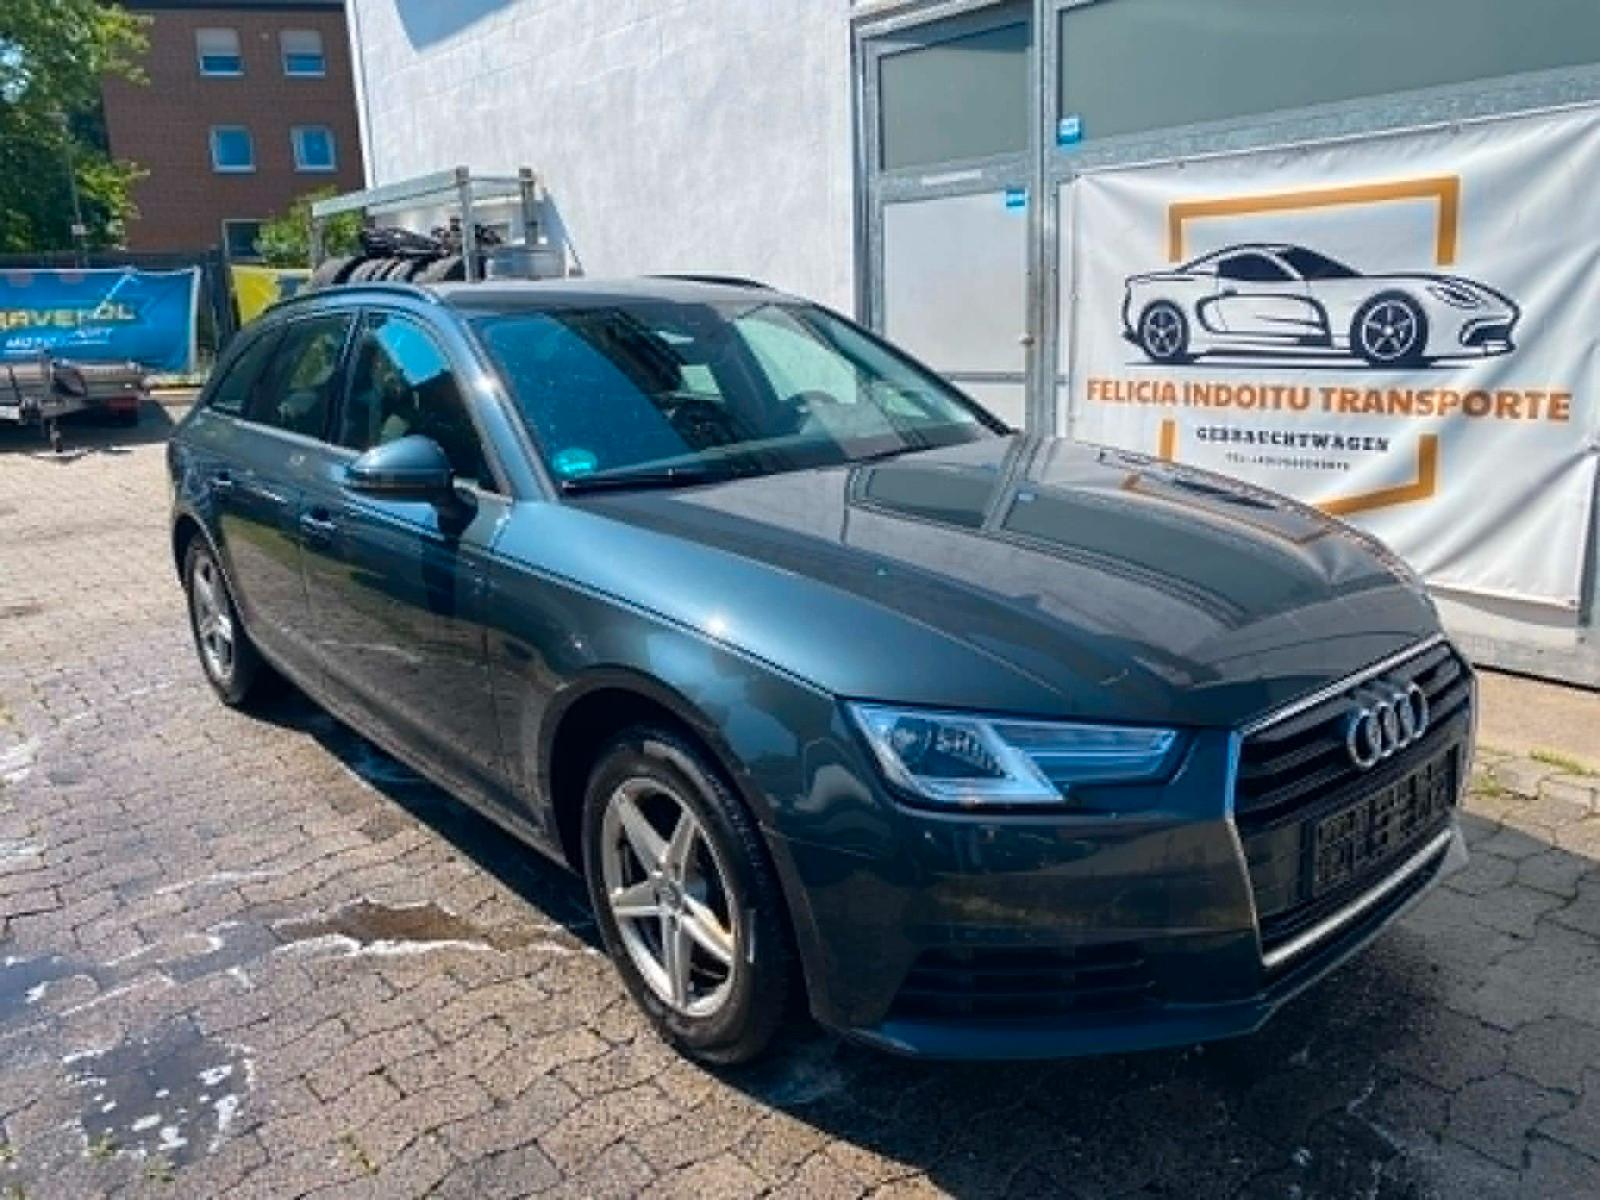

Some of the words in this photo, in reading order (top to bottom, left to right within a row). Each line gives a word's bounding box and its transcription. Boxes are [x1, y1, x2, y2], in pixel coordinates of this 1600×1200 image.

[1086, 380, 1176, 402] FELICIA
[1183, 382, 1310, 410] INDOITU
[1319, 387, 1572, 420] TRANSPORTE
